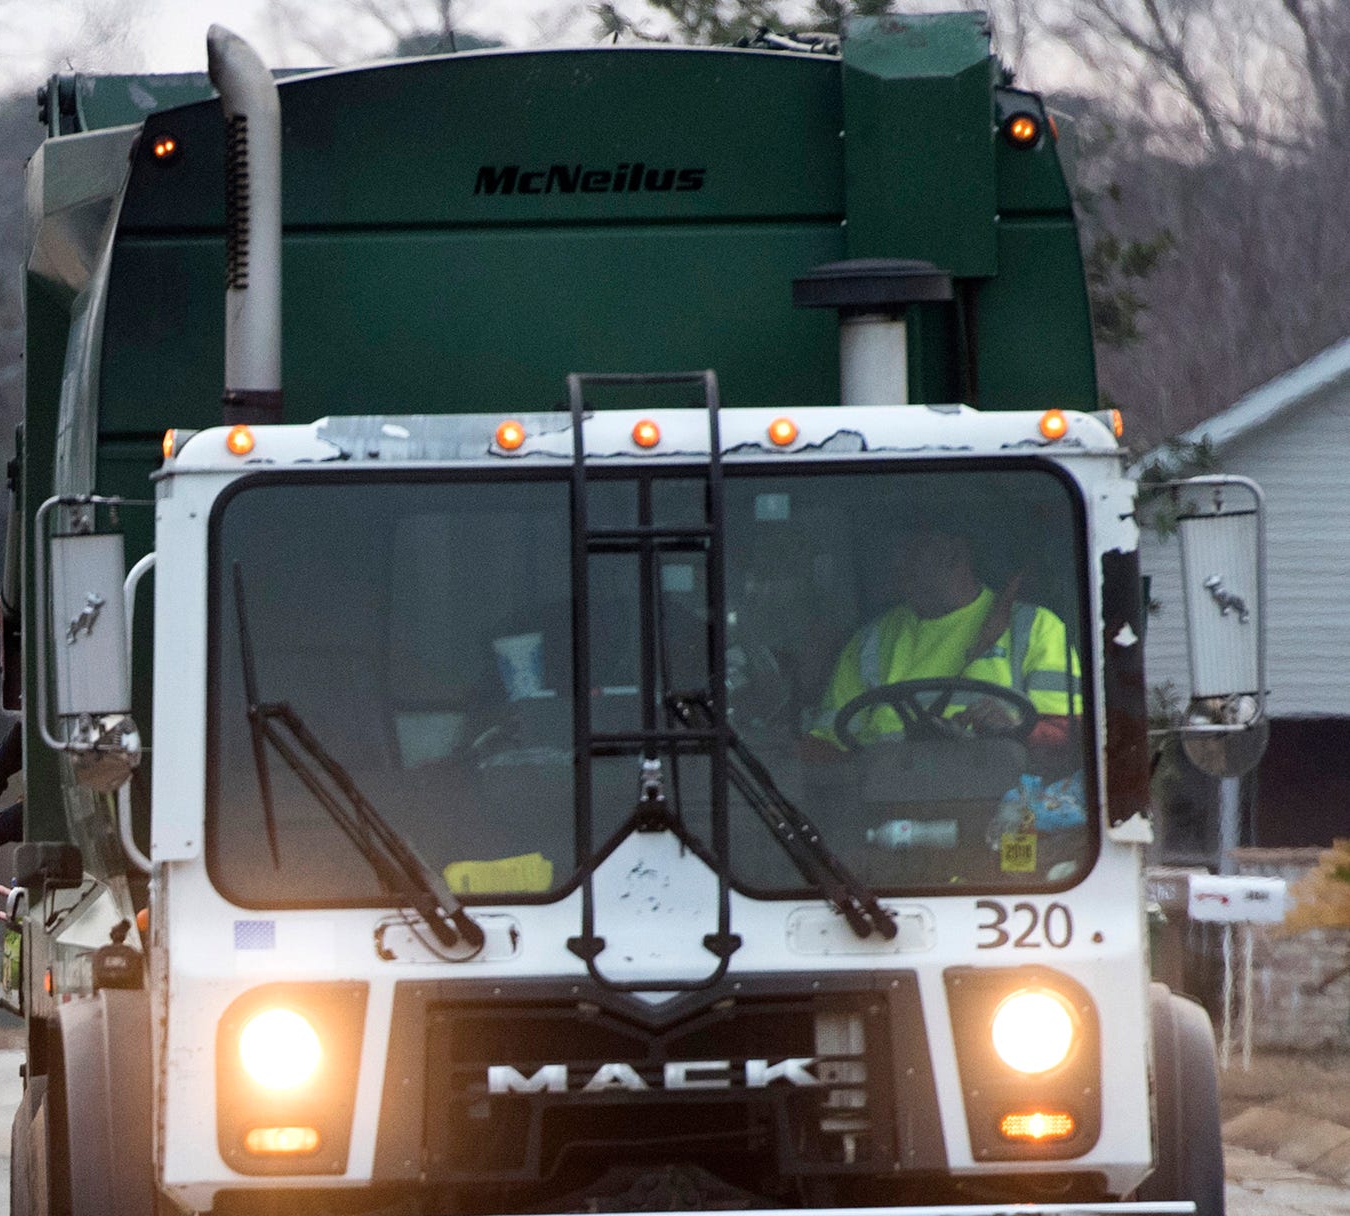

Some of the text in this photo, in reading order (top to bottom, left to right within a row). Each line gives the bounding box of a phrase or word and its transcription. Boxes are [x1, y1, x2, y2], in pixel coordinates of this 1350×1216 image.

[474, 162, 707, 196] McNeilus
[976, 900, 1073, 949] 320
[487, 1058, 821, 1093] MACK
